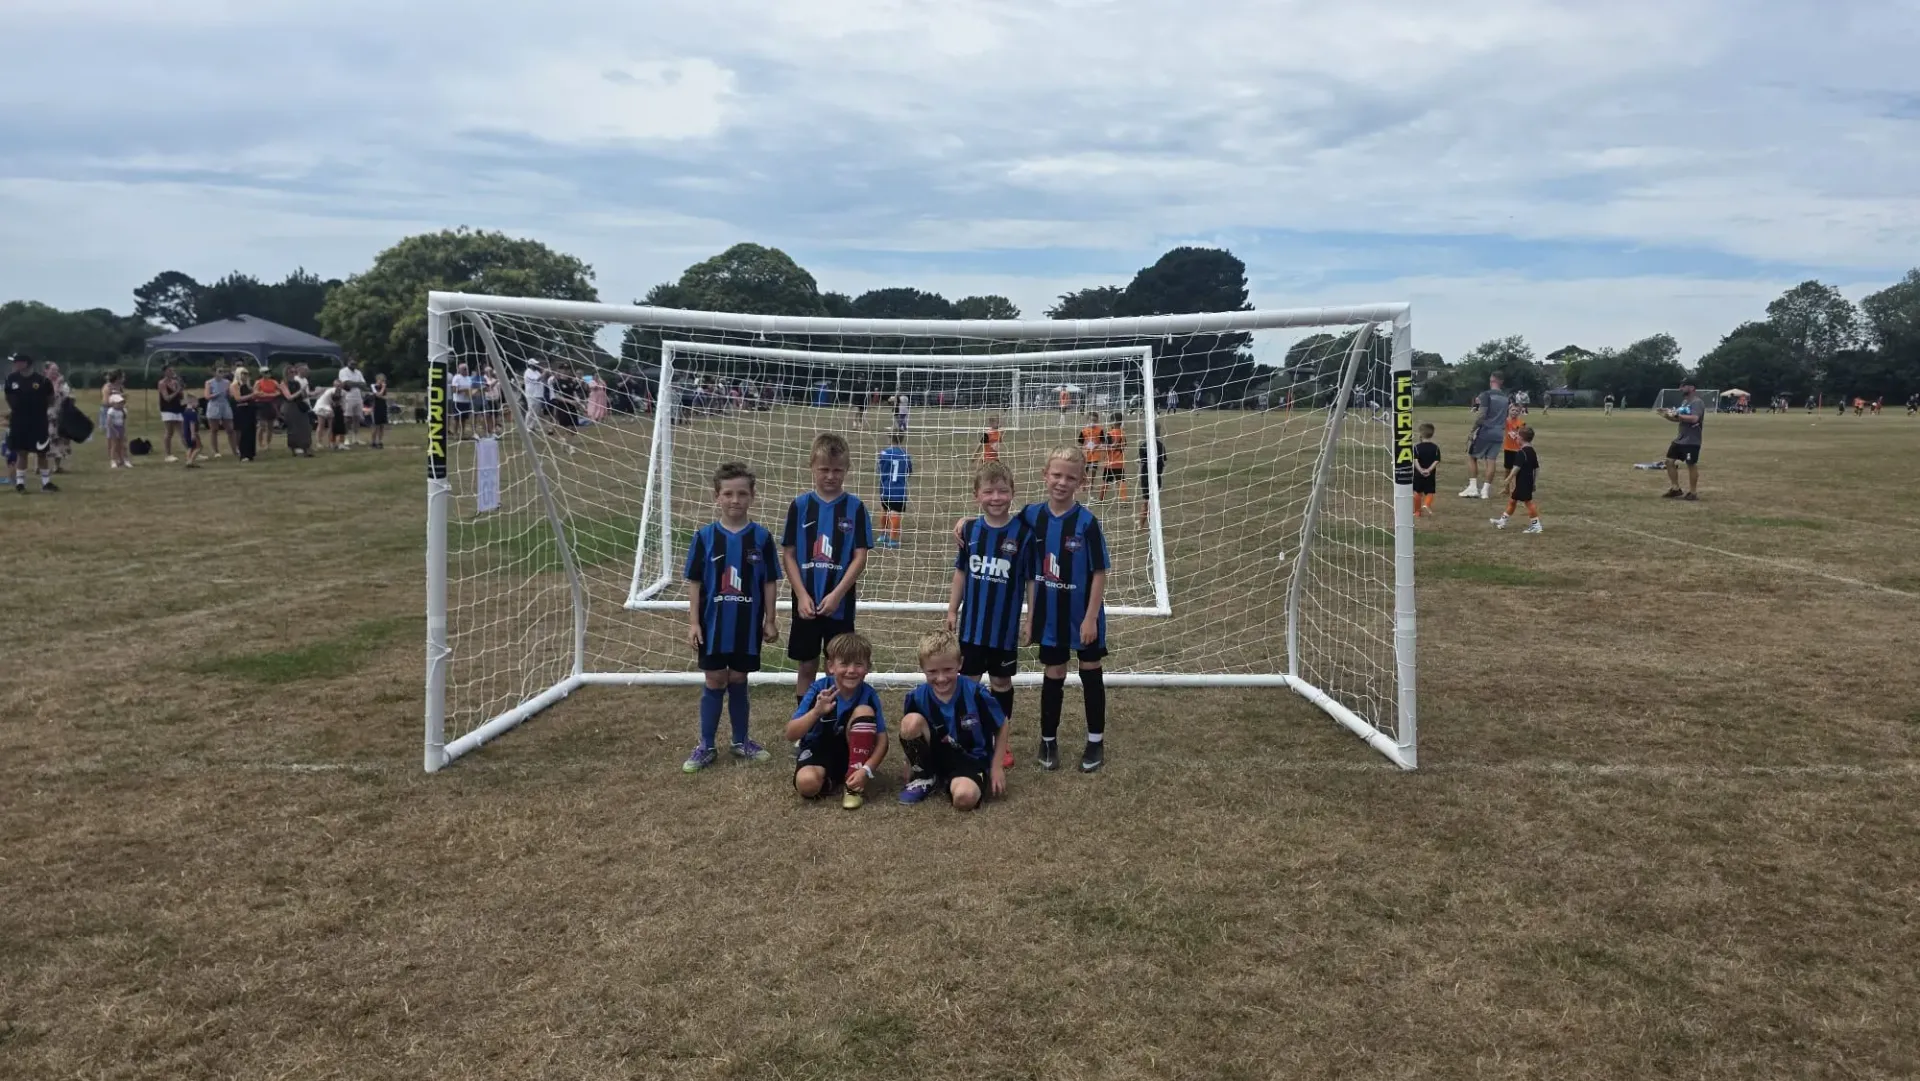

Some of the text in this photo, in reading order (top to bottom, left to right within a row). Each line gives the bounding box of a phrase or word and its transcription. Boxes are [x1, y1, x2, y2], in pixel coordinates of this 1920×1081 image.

[428, 368, 445, 458] FORZA
[1397, 376, 1413, 464] FORZA
[892, 460, 899, 482] 1
[1045, 581, 1077, 590] GROUP
